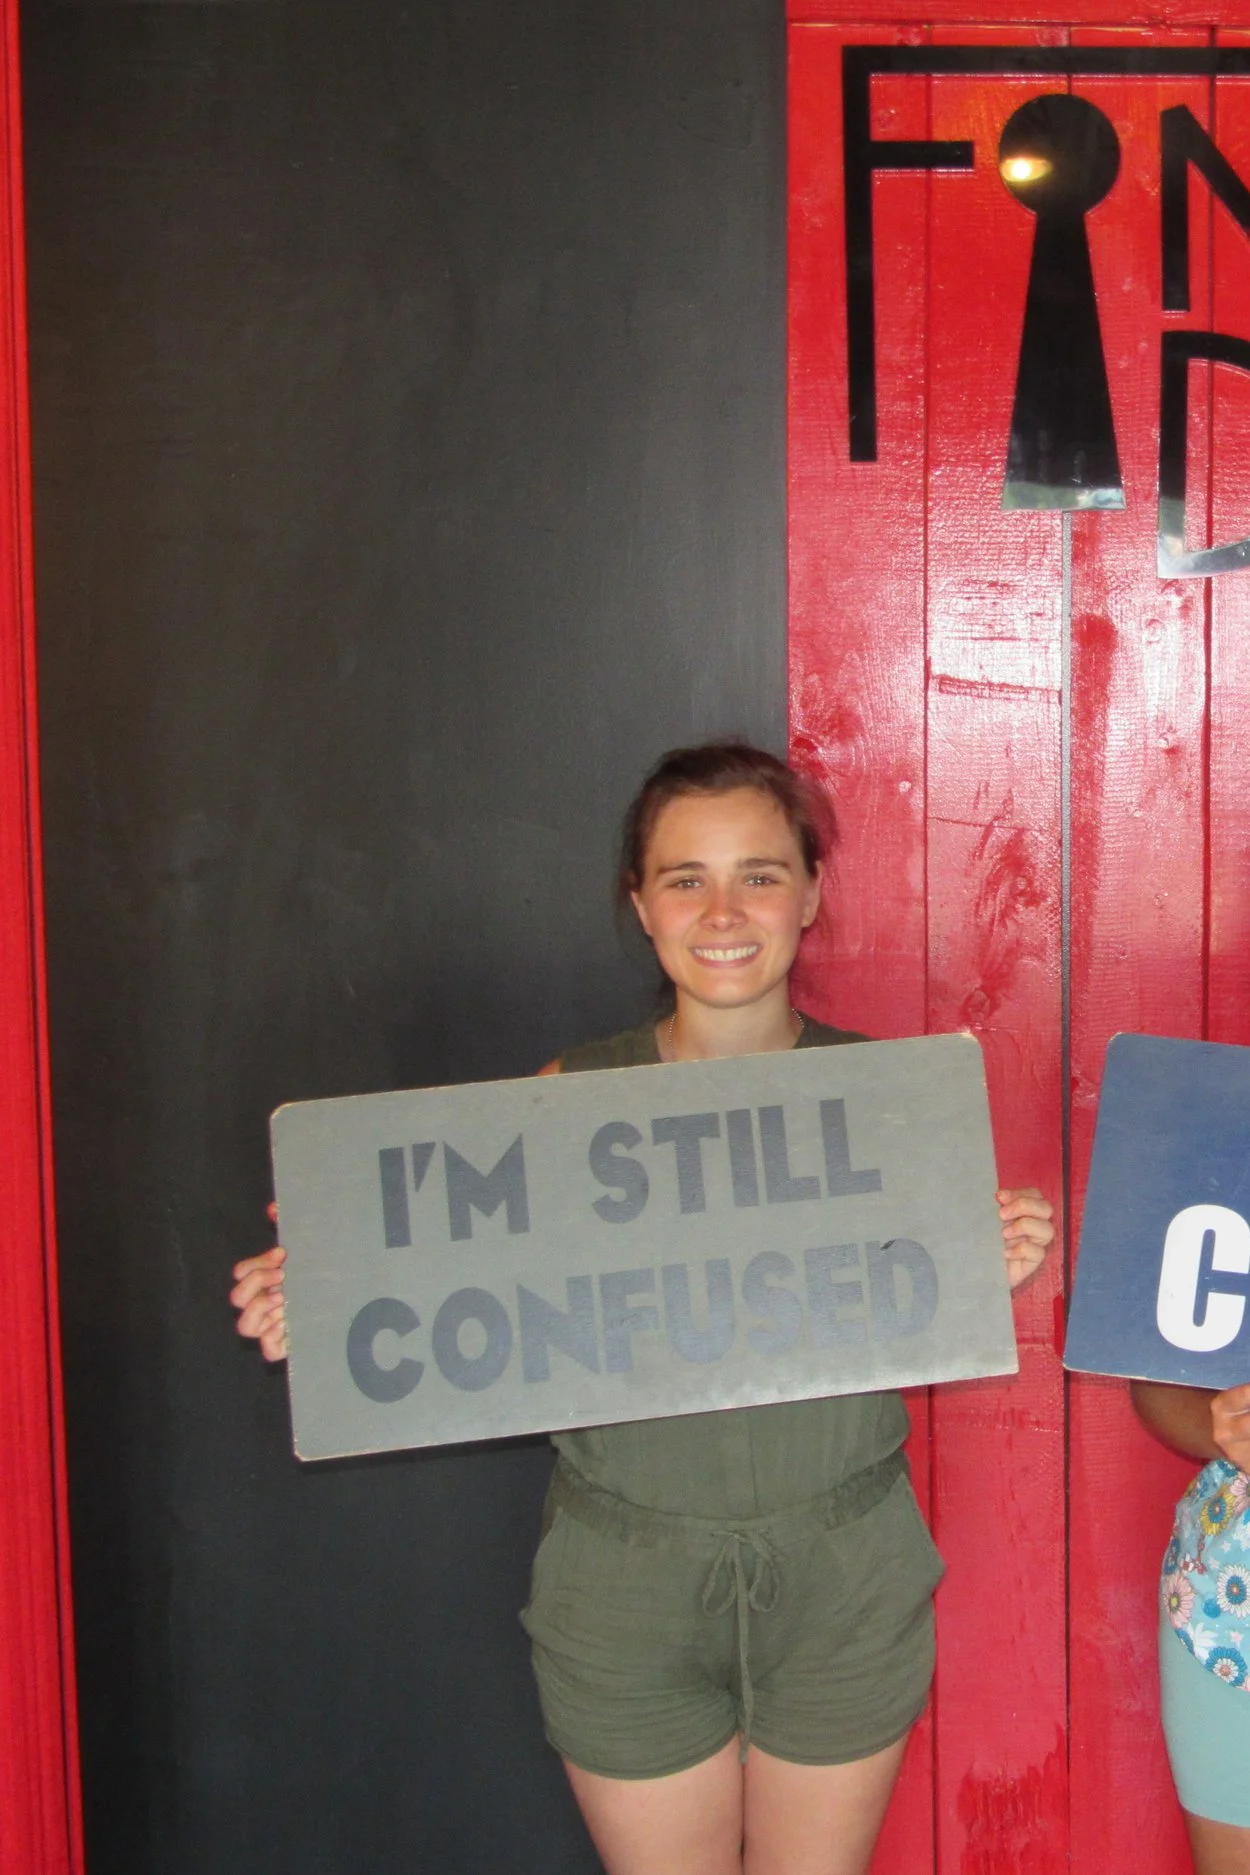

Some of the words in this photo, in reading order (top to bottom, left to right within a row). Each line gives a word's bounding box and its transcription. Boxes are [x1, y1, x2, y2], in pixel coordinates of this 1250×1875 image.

[378, 1132, 531, 1249] I'M
[588, 1098, 883, 1225] STILL
[346, 1238, 939, 1403] CONFUSED
